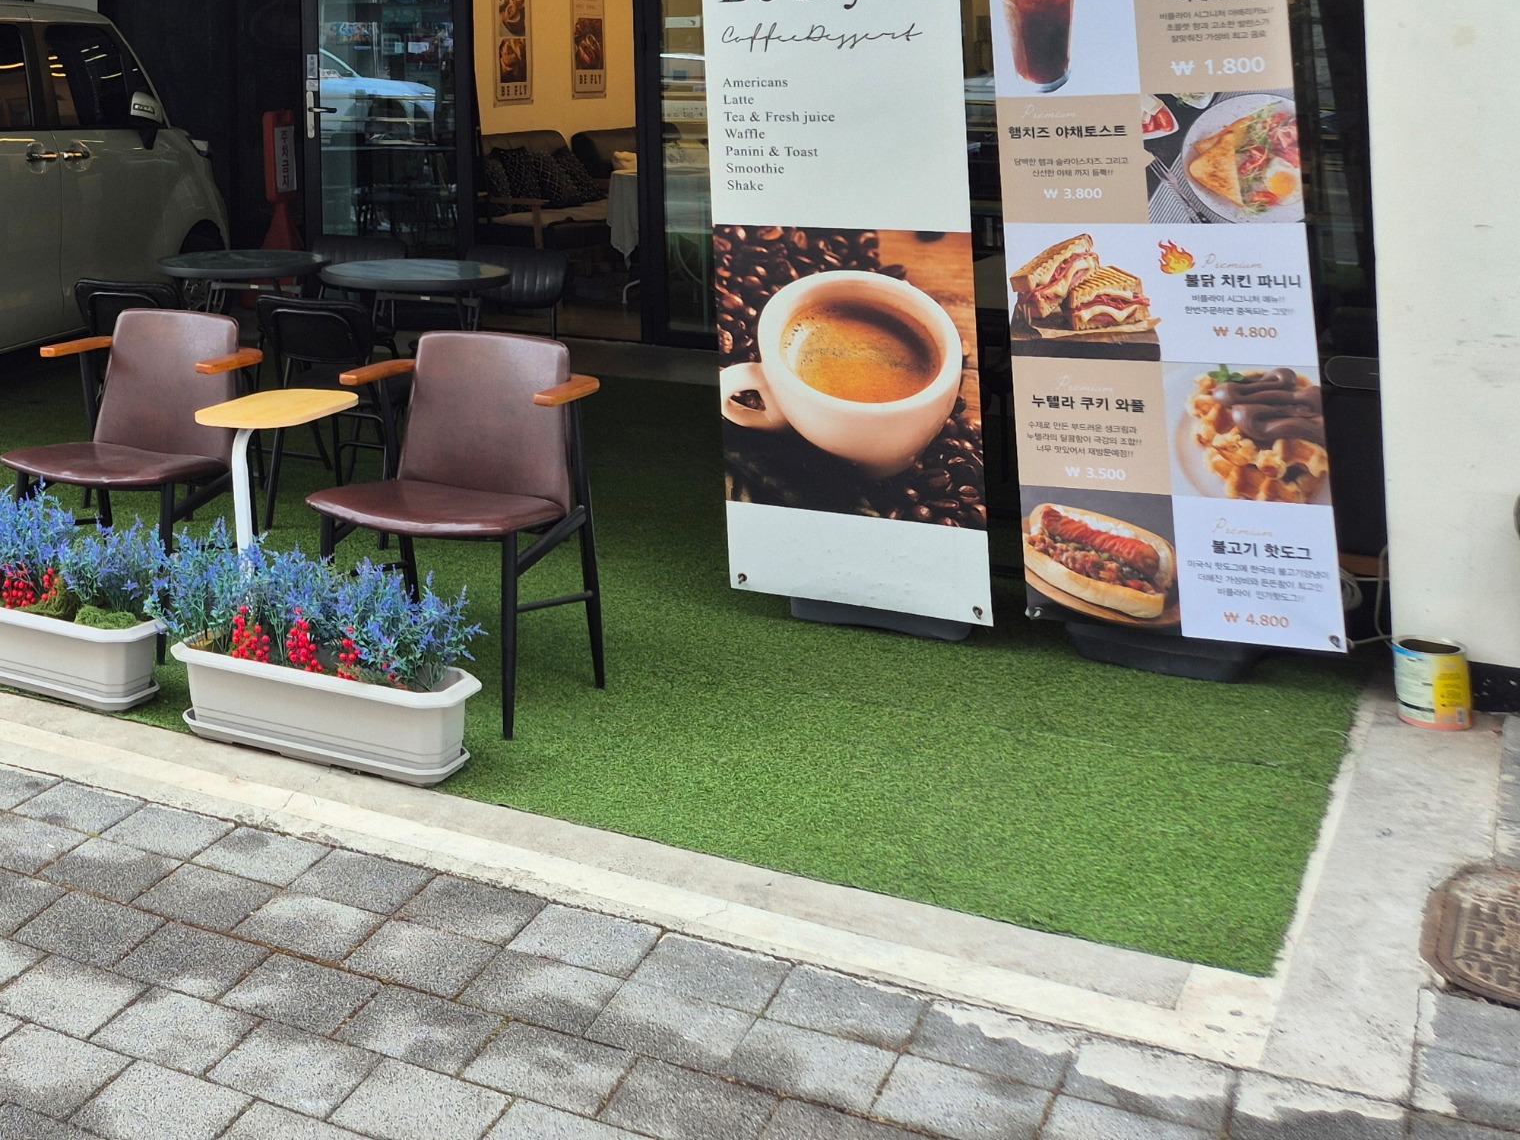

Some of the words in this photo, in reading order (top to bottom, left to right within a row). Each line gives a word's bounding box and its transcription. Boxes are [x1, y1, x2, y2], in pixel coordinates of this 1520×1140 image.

[1211, 20, 1236, 29] 고소한
[1205, 32, 1229, 41] 가성비
[1232, 31, 1248, 40] 최고
[1170, 60, 1195, 76] ₩
[1204, 56, 1266, 75] 1.800
[579, 74, 588, 84] BE
[590, 74, 602, 84] FLY
[723, 77, 789, 88] Americans
[501, 86, 510, 96] BE
[514, 85, 528, 96] FLY
[723, 94, 755, 105] Latte
[1021, 103, 1077, 119] Premium
[724, 111, 745, 122] Tea
[750, 112, 761, 122] &
[766, 111, 800, 122] Fresh
[803, 111, 835, 125] juice
[725, 128, 765, 139] Waffle
[1008, 126, 1051, 139] 햄치즈
[1055, 125, 1128, 139] 야채토스트
[725, 145, 764, 157] Panini
[769, 146, 780, 157] &
[784, 146, 819, 157] Toast
[280, 130, 290, 188] 주차금지
[1105, 157, 1129, 165] 그리고
[726, 162, 785, 174] Smoothie
[1032, 169, 1055, 178] 신선한
[1056, 169, 1072, 177] 야채
[1074, 169, 1090, 177] 까지
[727, 179, 764, 191] Shake
[1043, 188, 1058, 199] ₩
[1064, 188, 1102, 199] 3.800
[1201, 253, 1264, 269] Premium
[1184, 274, 1216, 288] 불닭
[1221, 274, 1253, 289] 치킨
[1257, 274, 1302, 289] 파니니
[1227, 294, 1261, 303] 시그니처
[1212, 326, 1229, 337] ₩
[1234, 326, 1278, 339] 4.800
[1031, 394, 1076, 409] 누텔라
[1080, 396, 1110, 411] 쿠키
[1115, 398, 1146, 413] 와플
[1027, 421, 1051, 430] 수제로
[1052, 421, 1069, 430] 만든
[1071, 422, 1103, 433] 부드러운
[1036, 444, 1052, 453] 너무
[1054, 445, 1086, 455] 맛있어서
[1086, 467, 1126, 480] 3.500
[1211, 539, 1258, 557] 불고기
[1264, 543, 1313, 560] 핫도그
[1186, 560, 1213, 569] 미국식
[1250, 564, 1276, 575] 한국의
[1197, 573, 1223, 583] 더해진
[1246, 613, 1290, 628] 4.800
